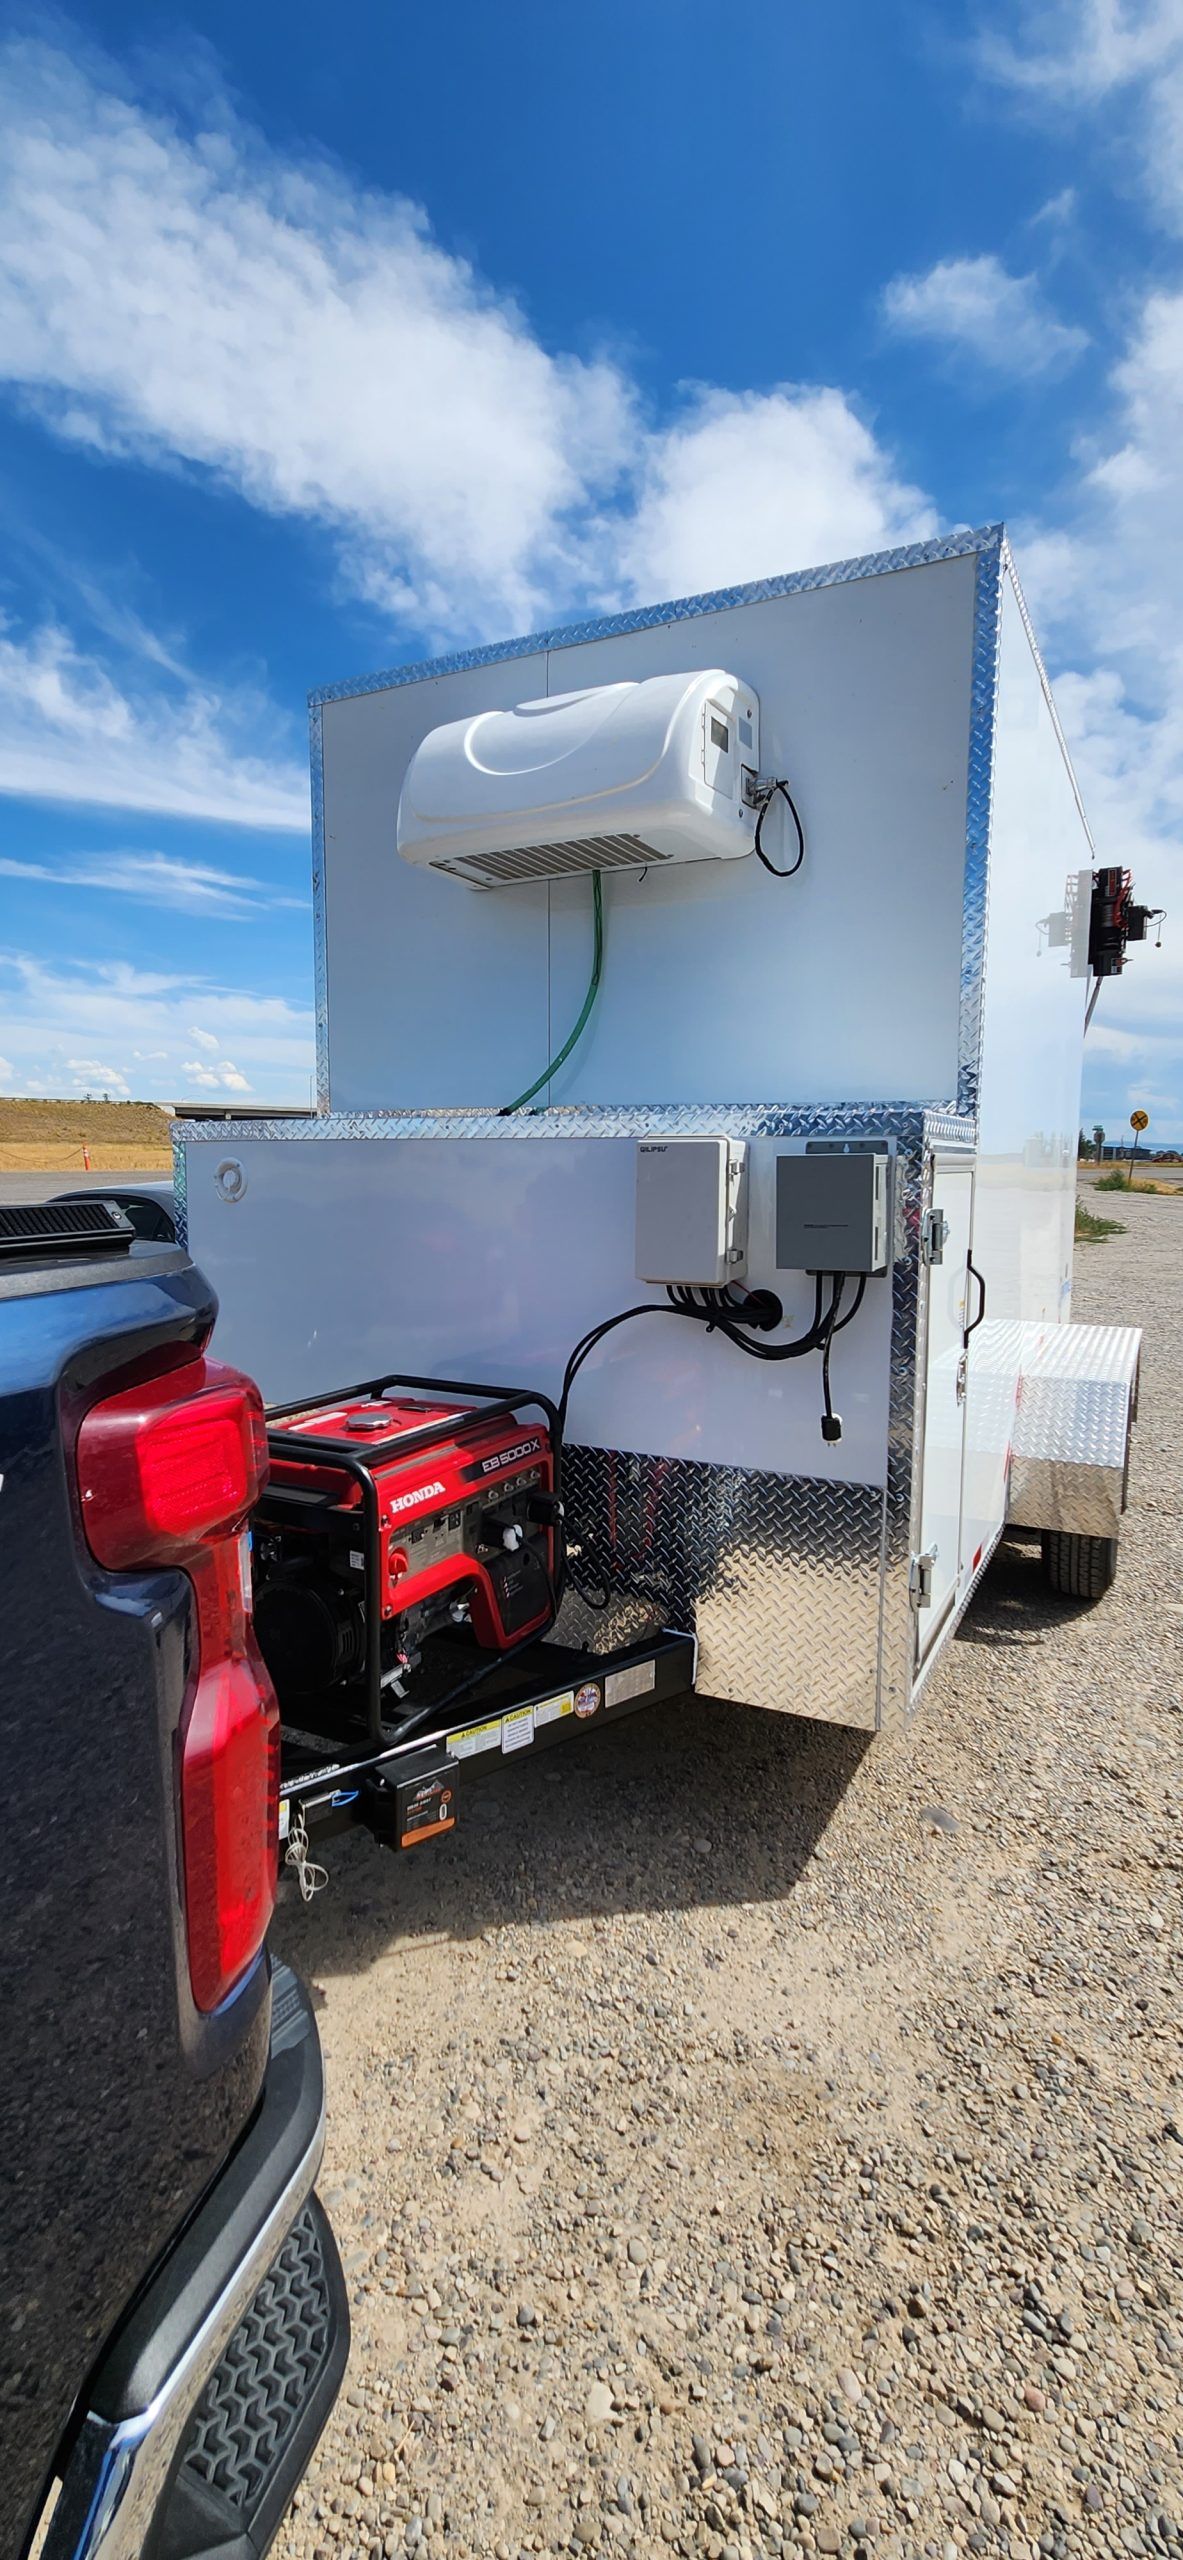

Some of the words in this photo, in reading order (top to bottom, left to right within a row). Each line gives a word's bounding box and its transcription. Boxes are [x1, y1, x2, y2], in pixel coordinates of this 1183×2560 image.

[390, 1481, 446, 1513] HONDA
[511, 1708, 531, 1721] CAUTION
[466, 1725, 487, 1737] CAUTION
